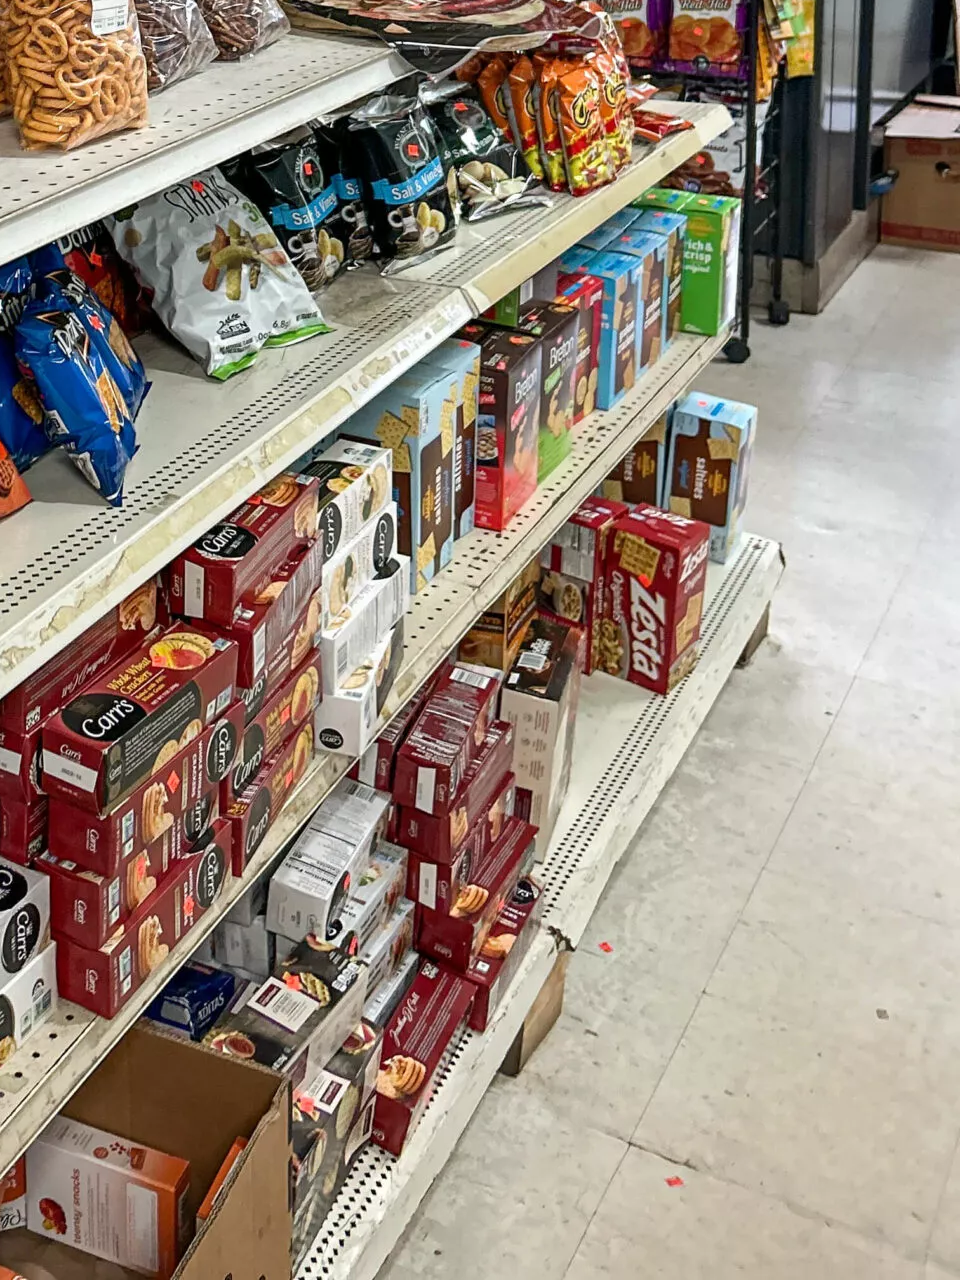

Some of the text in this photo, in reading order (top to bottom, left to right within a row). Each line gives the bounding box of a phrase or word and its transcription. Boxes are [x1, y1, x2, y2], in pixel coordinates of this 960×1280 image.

[391, 182, 414, 201] Salt
[414, 179, 421, 193] &
[549, 336, 575, 369] Breton
[514, 367, 538, 405] Breton
[202, 525, 238, 553] Carr's
[324, 506, 334, 558] Carr's
[678, 540, 709, 584] Zesta
[629, 576, 669, 682] Zesta
[106, 657, 153, 692] Whole Wheat
[119, 670, 153, 696] Crackers
[81, 697, 135, 739] Carr's
[217, 727, 230, 774] Carr's
[16, 910, 30, 962] Carr's
[71, 1168, 81, 1207] snacks
